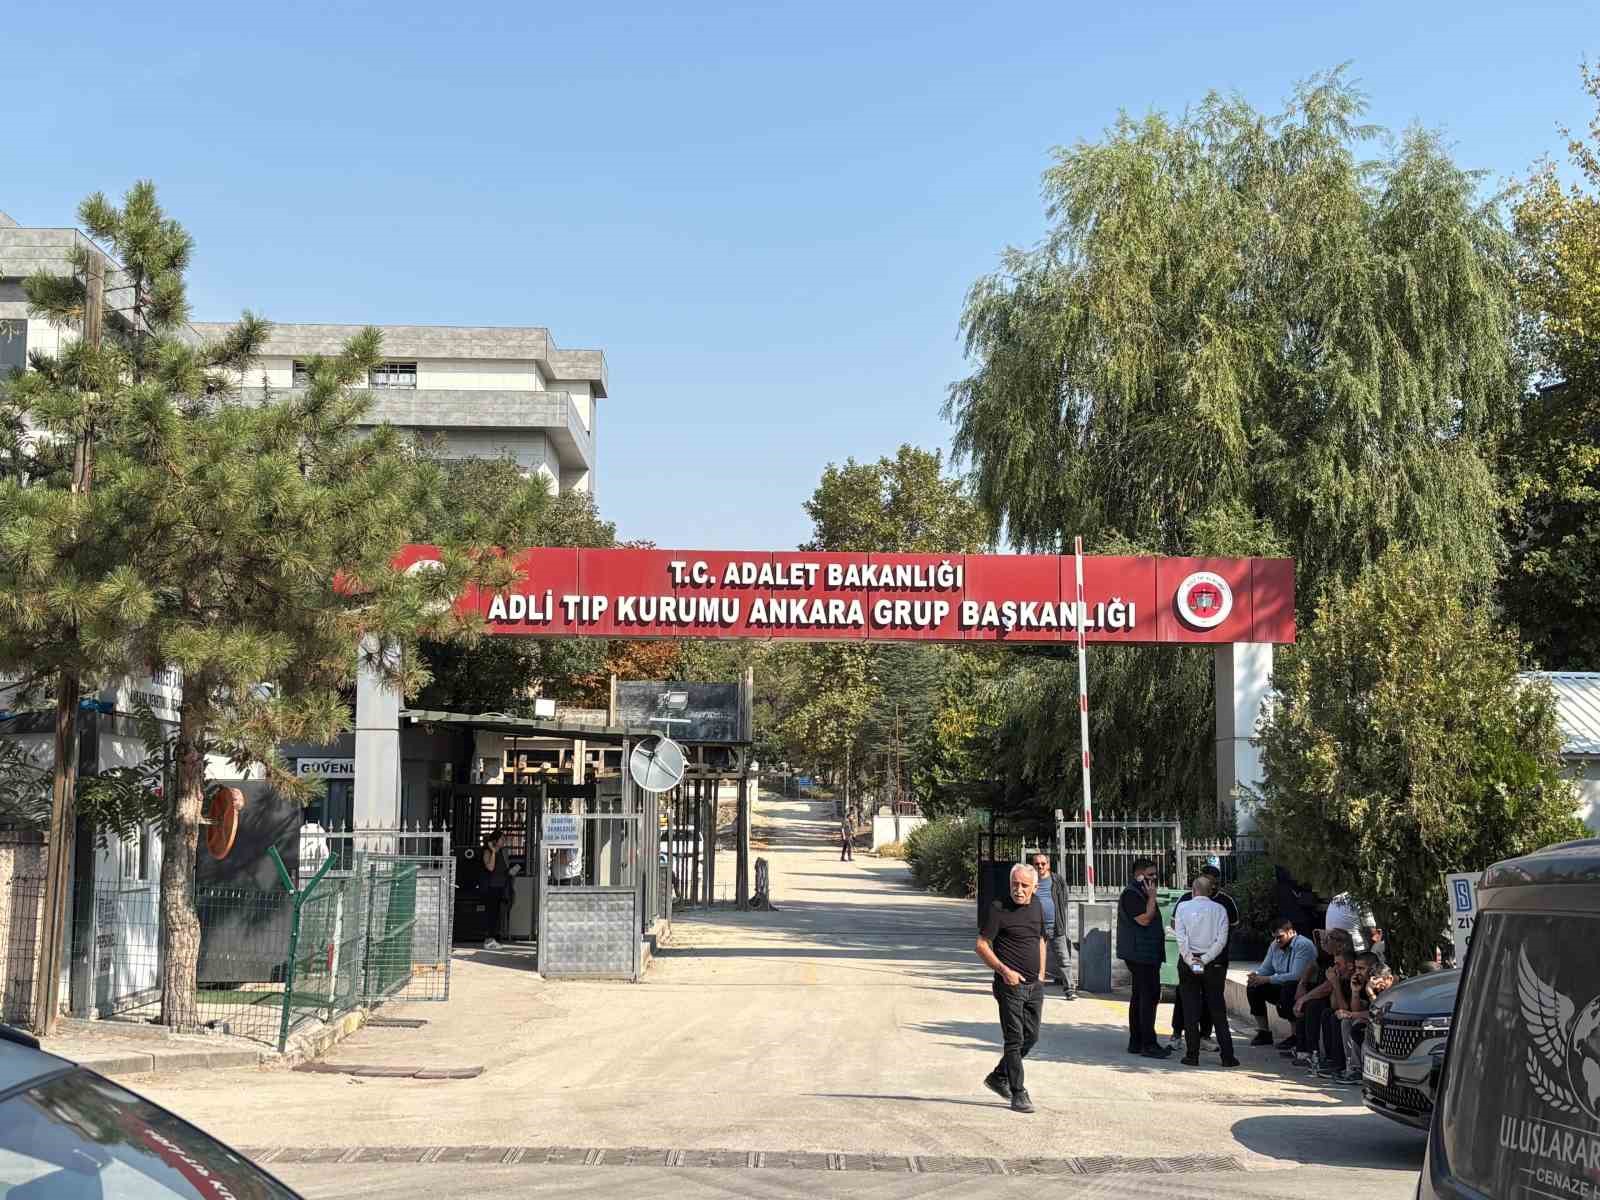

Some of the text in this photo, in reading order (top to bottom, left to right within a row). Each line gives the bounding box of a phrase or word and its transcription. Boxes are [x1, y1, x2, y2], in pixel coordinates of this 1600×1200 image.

[671, 560, 963, 587] T.C. ADALET BAKANLIĞI
[488, 589, 1136, 631] ADLİ TIP KURUMU ANKARA GRUP BAŞKANLIĞI
[1535, 1167, 1590, 1198] CENAZE
